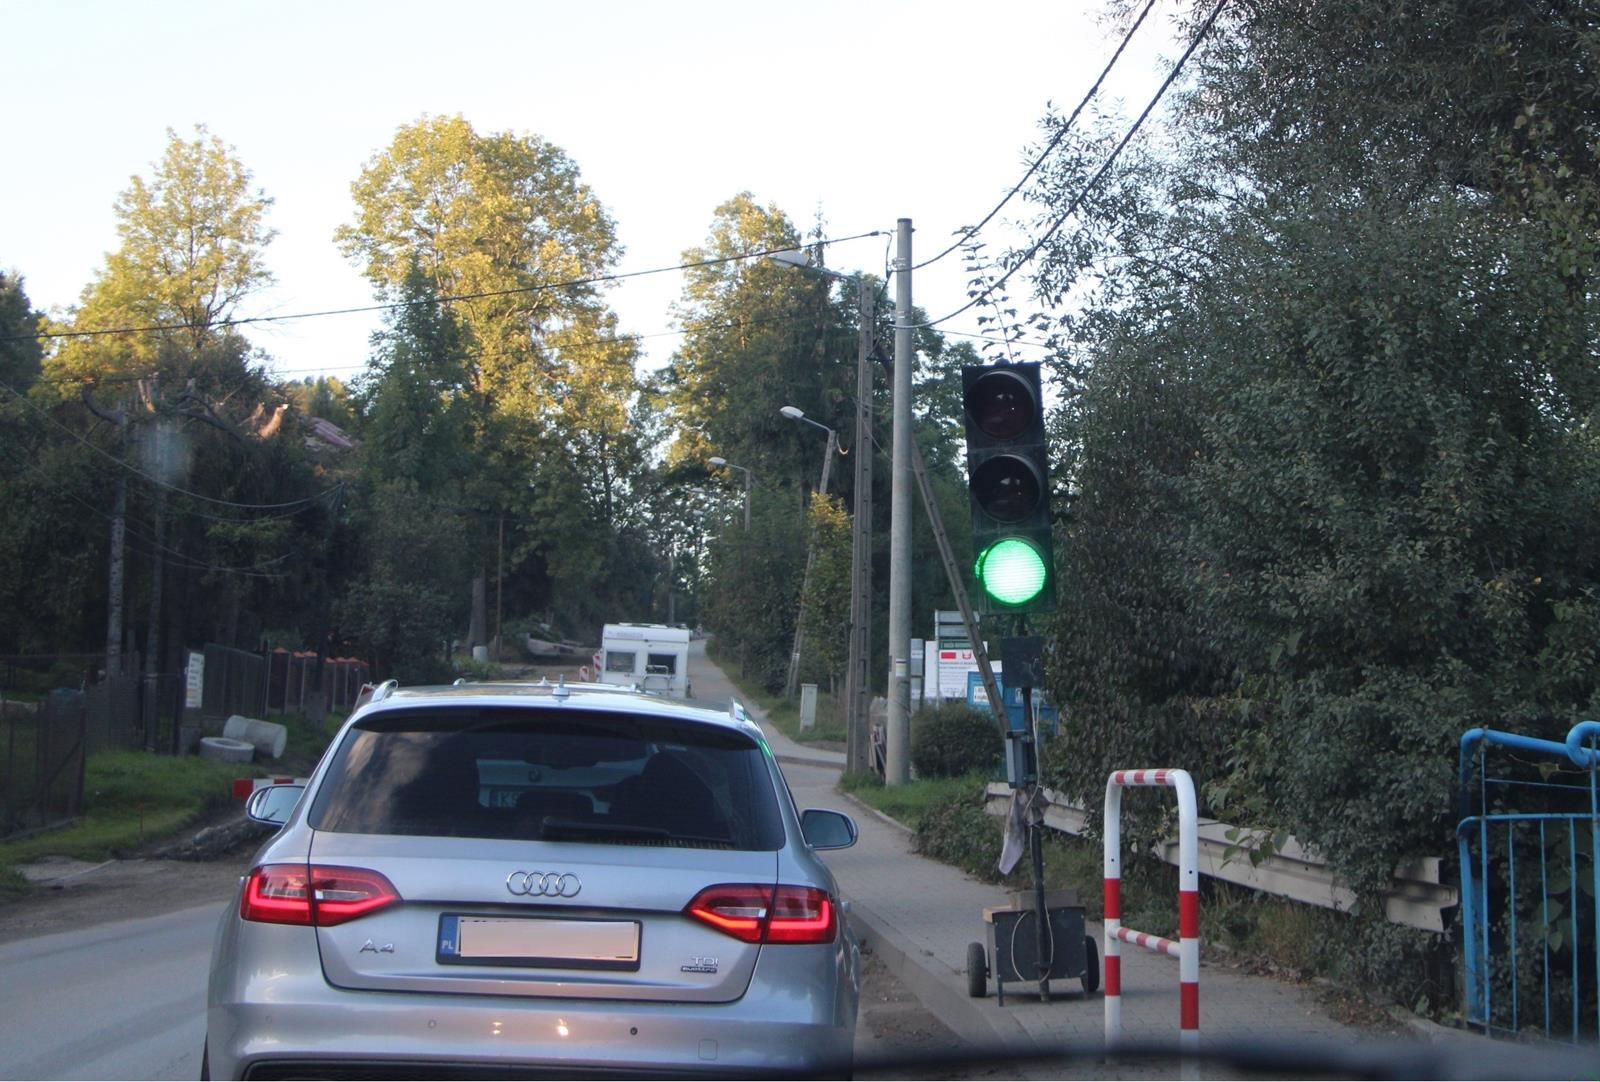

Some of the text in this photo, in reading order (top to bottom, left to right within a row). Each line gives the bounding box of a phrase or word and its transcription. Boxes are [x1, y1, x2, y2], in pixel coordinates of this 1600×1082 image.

[359, 938, 395, 953] A4
[441, 939, 454, 950] PL
[690, 955, 719, 966] TDI
